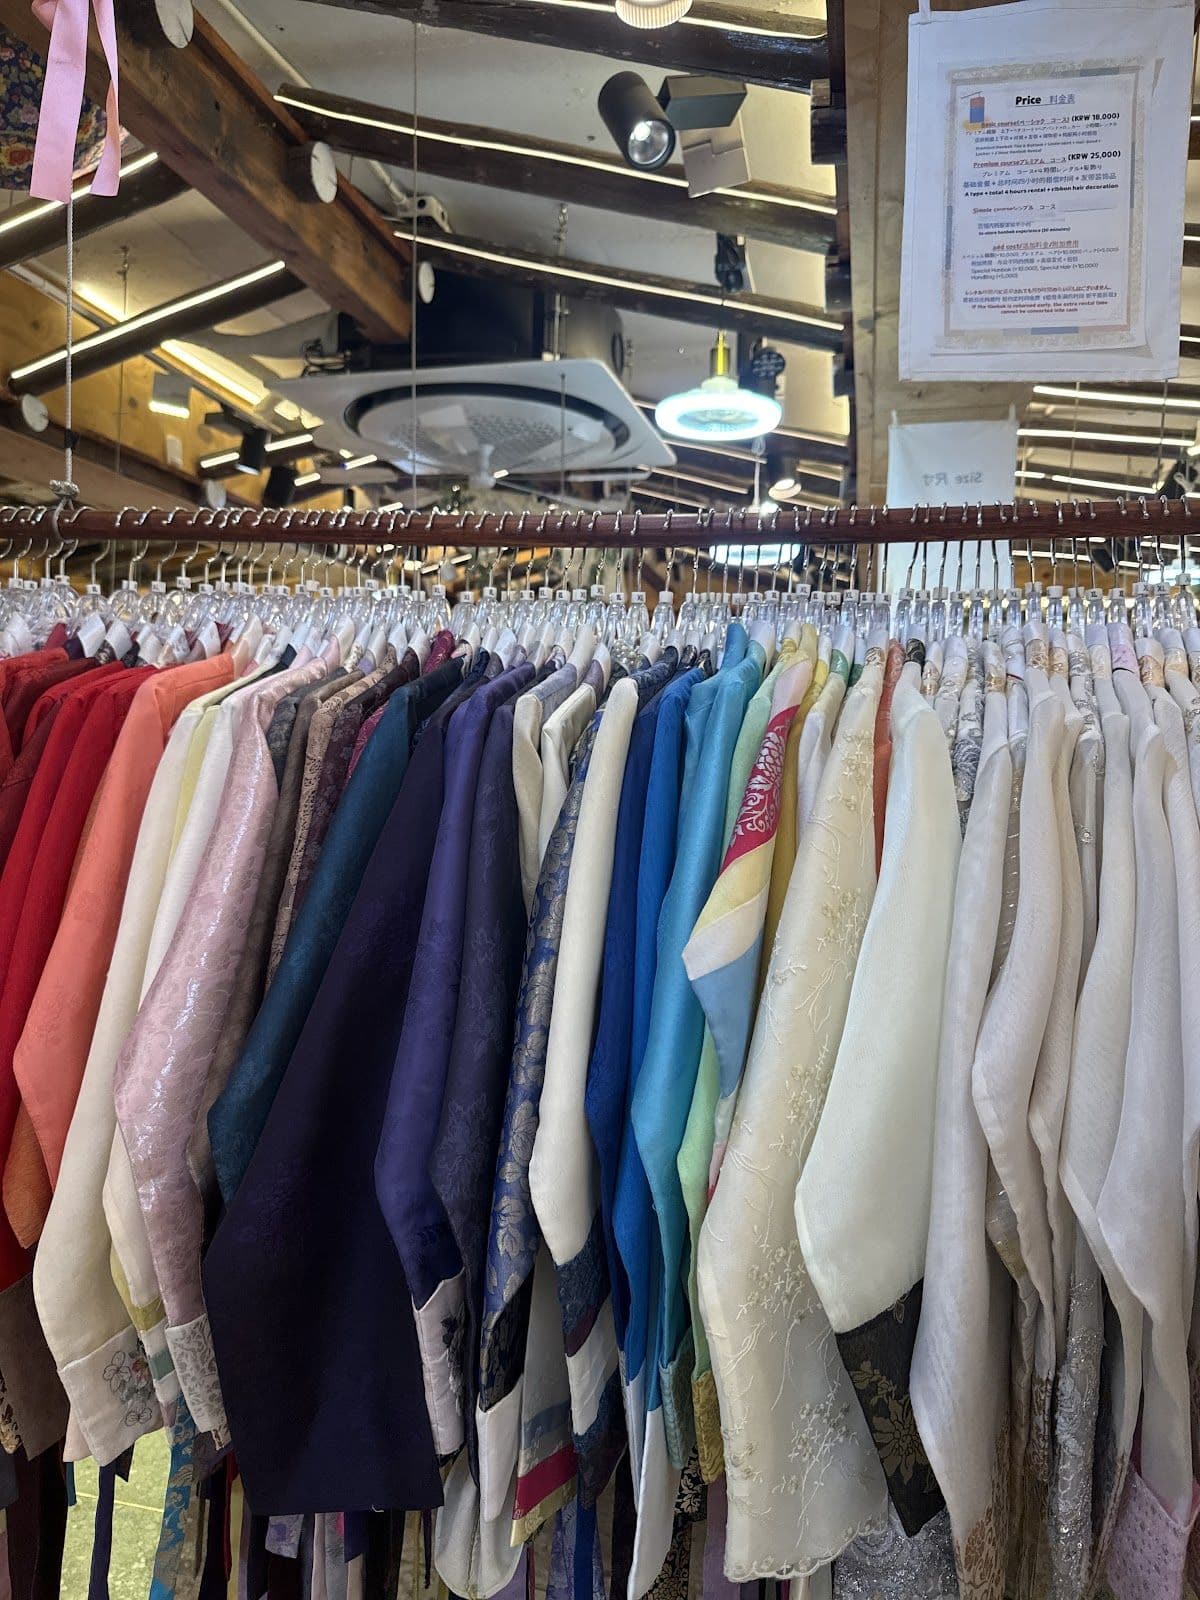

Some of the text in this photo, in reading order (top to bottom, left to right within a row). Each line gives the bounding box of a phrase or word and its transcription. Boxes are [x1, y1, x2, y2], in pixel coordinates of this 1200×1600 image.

[1015, 93, 1075, 106] Price 料金表
[1071, 113, 1090, 122] (KRW
[1091, 111, 1120, 121] 18,000)
[1068, 152, 1088, 161] (KRW
[1090, 150, 1121, 160] 25,000)
